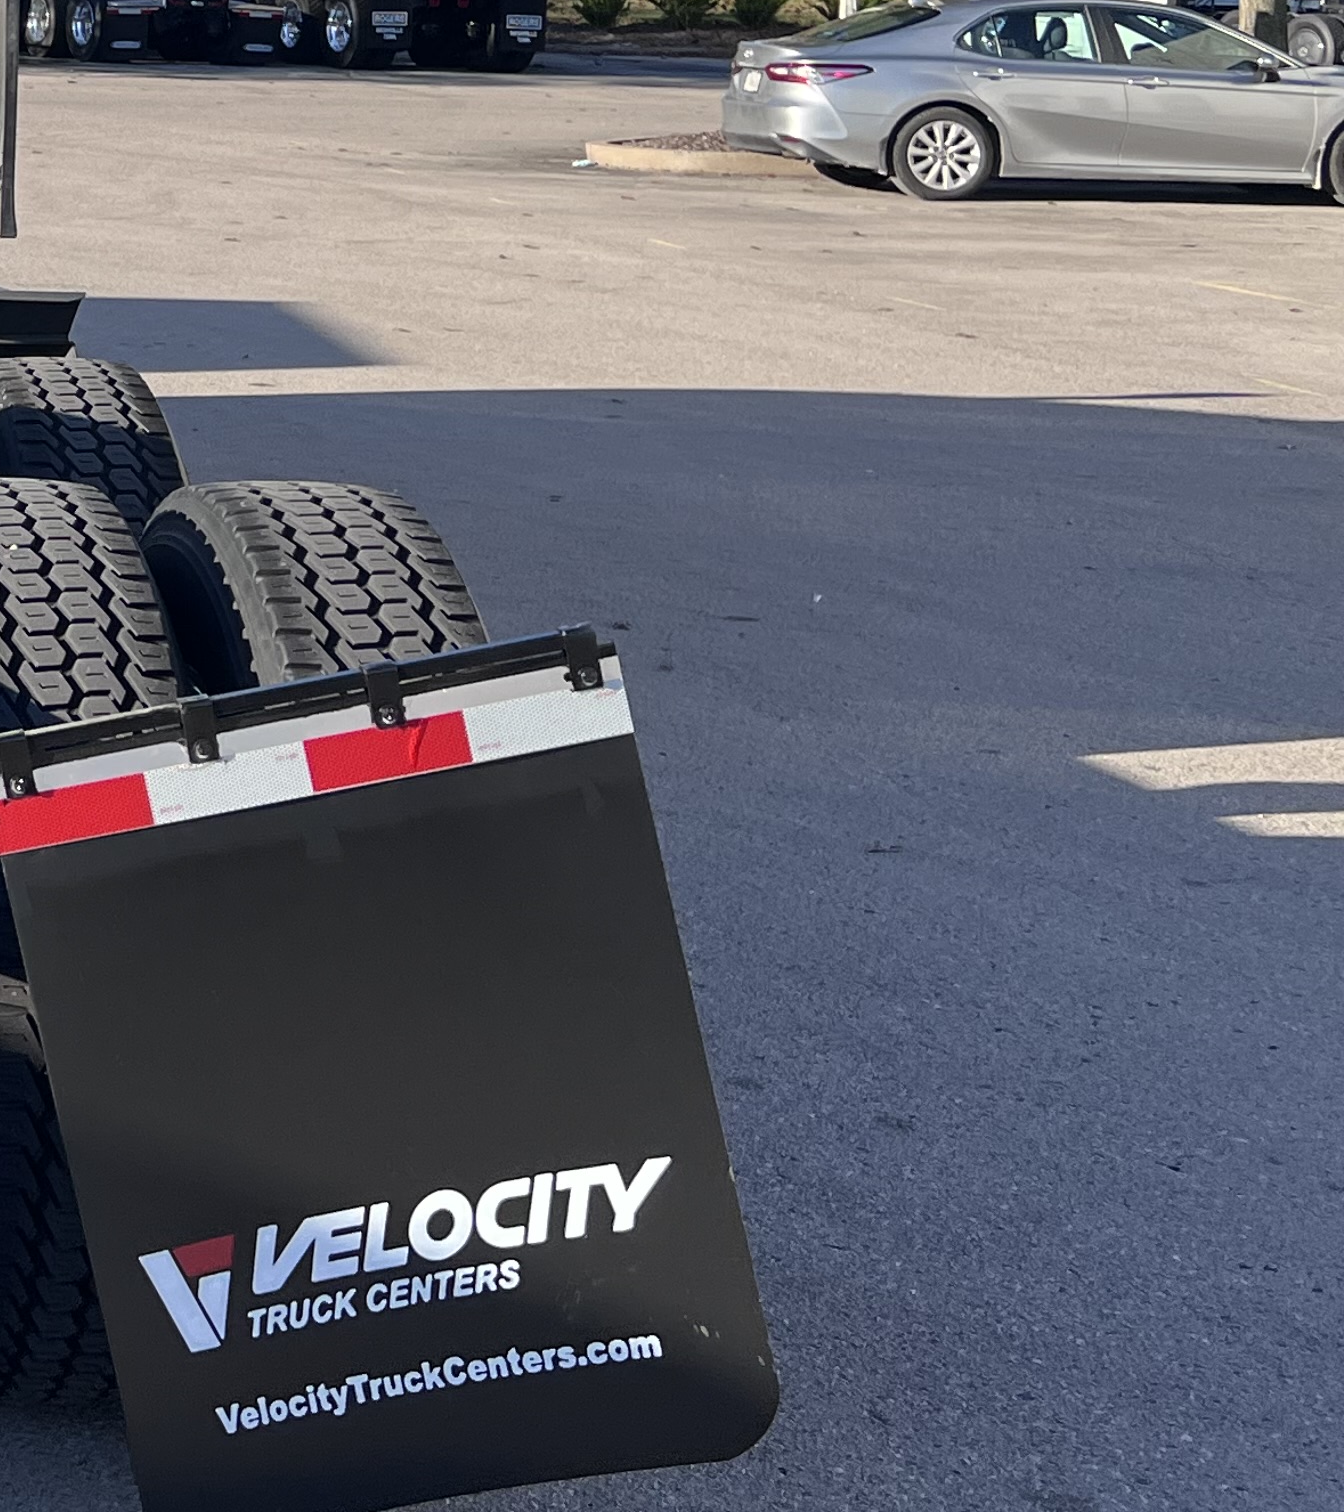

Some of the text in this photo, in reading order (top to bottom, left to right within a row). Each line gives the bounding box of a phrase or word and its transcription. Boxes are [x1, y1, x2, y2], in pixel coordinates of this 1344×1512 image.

[252, 1155, 672, 1294] VELOCITY
[248, 1259, 521, 1338] TRUCK CENTERS
[215, 1332, 663, 1434] VelocityTruckCenters.com
